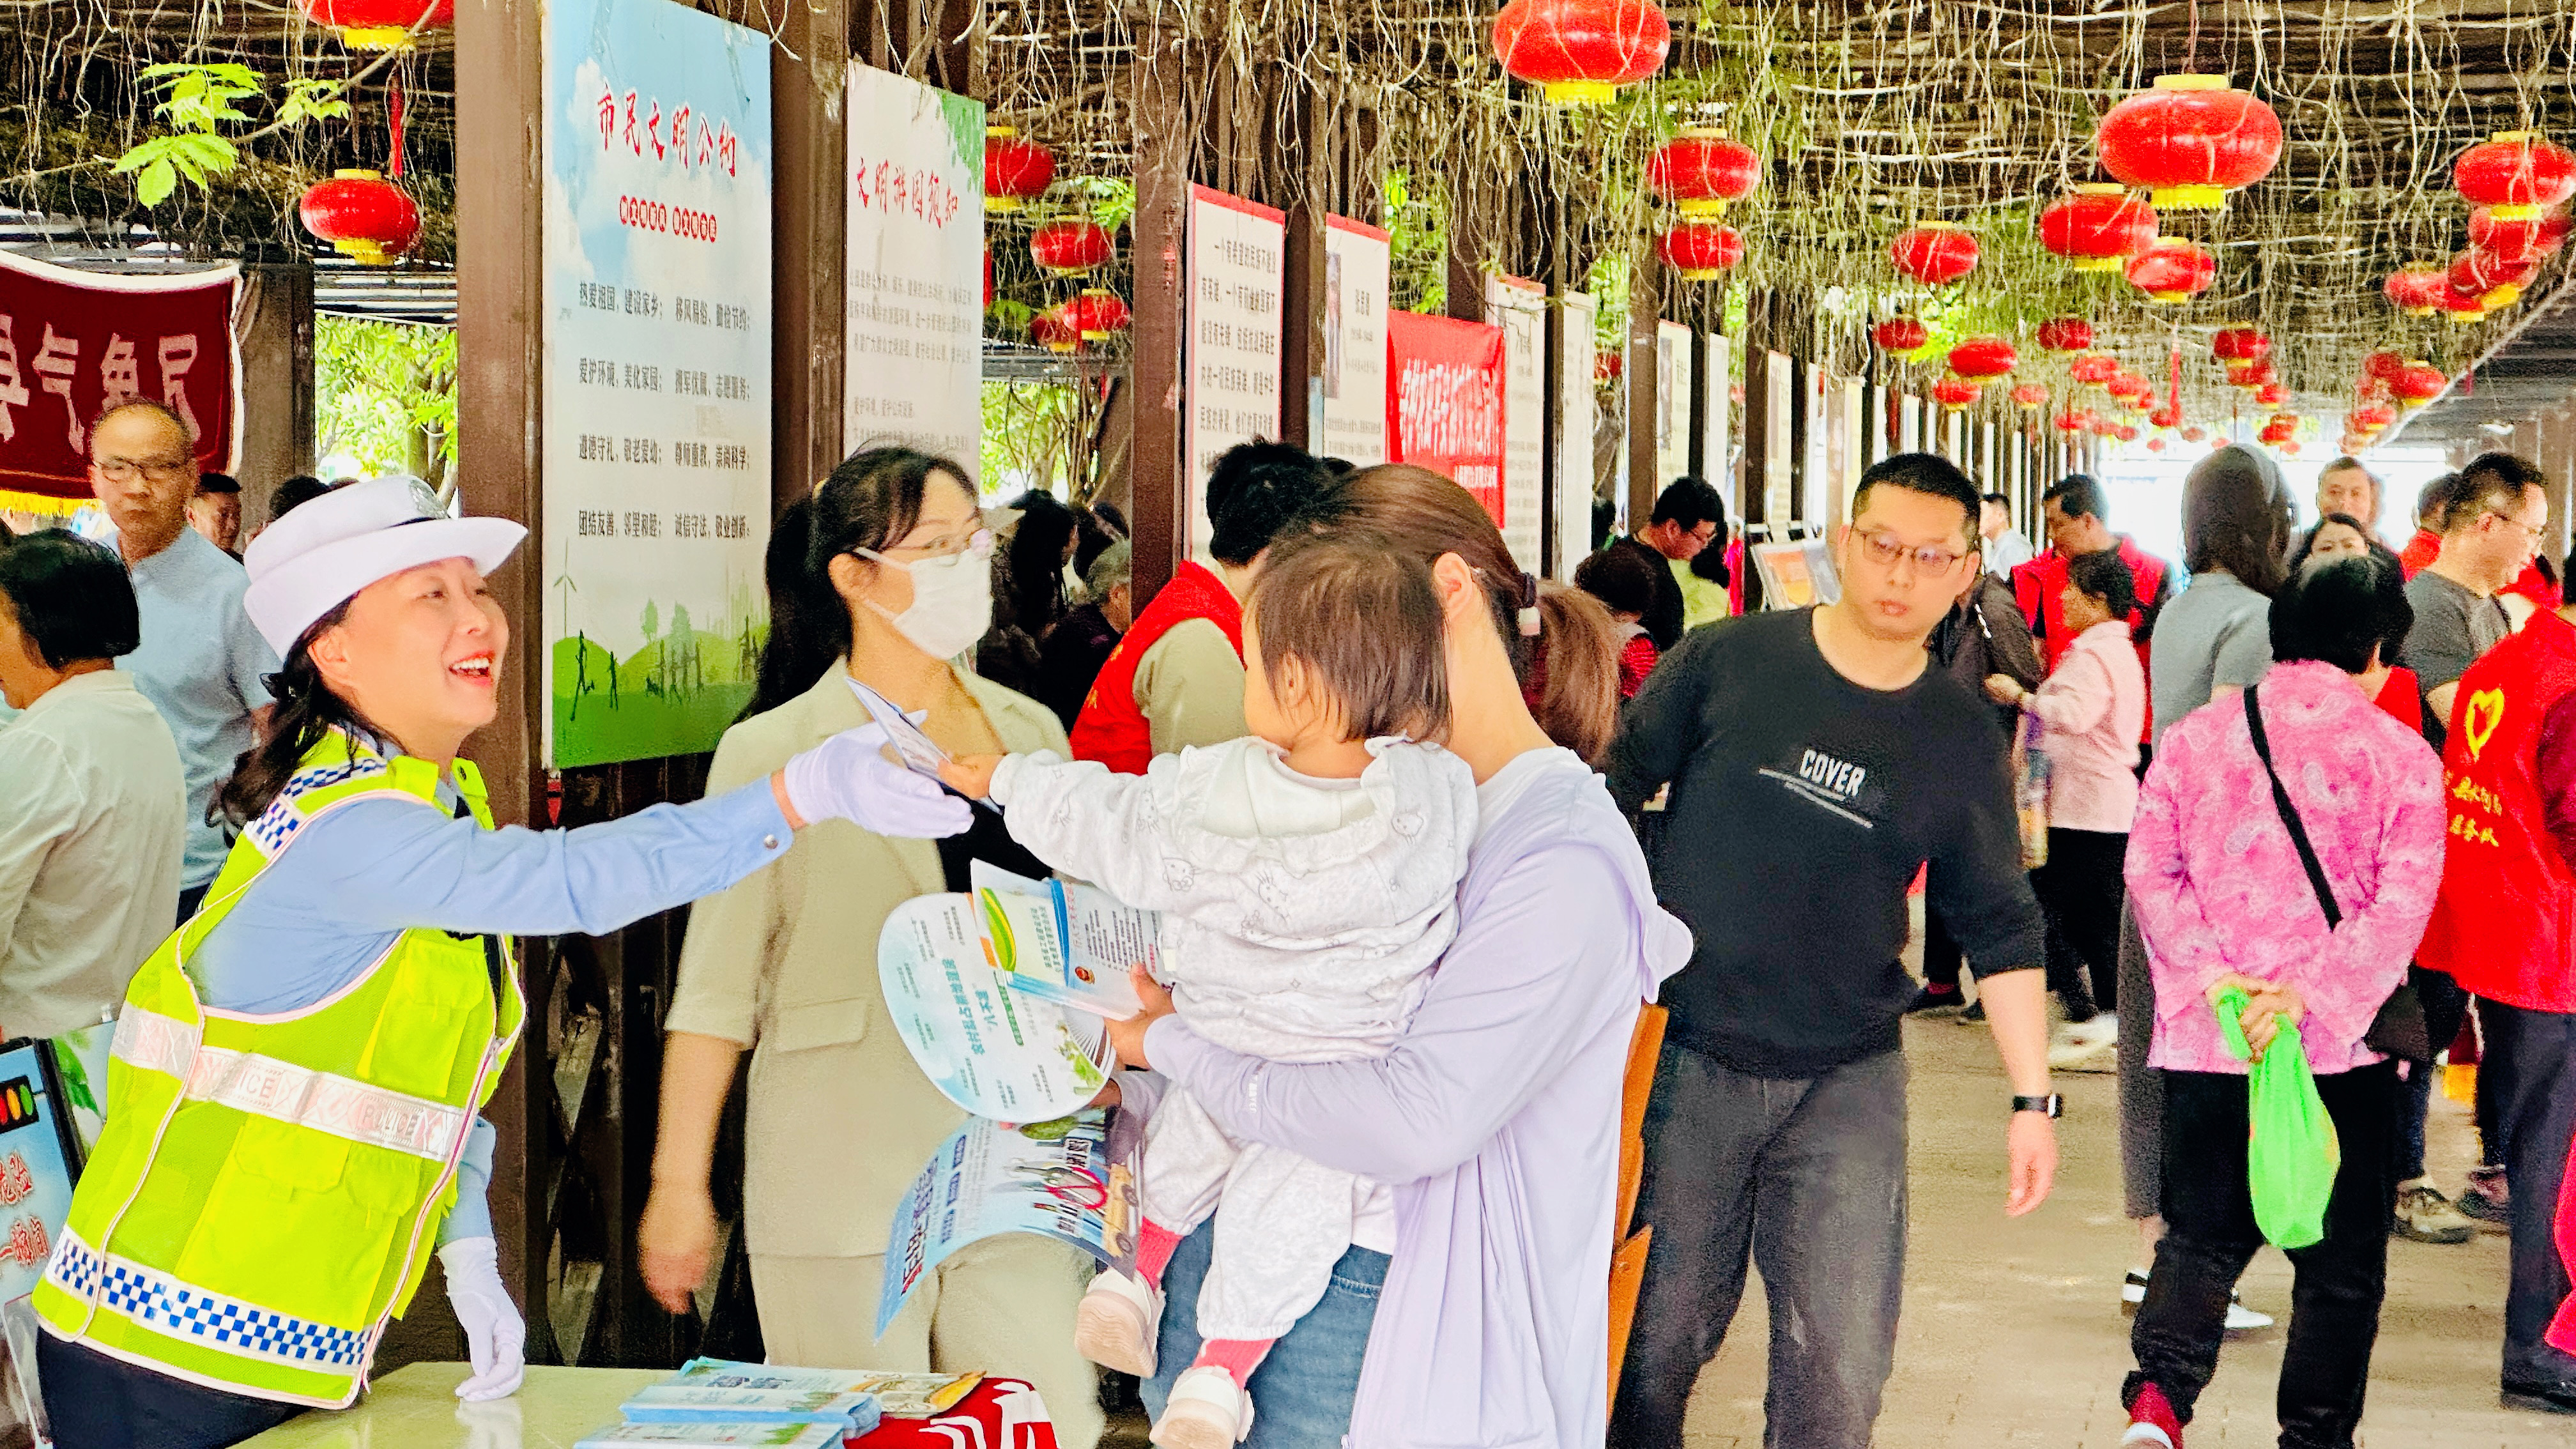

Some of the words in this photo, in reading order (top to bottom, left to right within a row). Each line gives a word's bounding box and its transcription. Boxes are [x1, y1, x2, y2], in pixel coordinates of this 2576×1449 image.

[597, 80, 736, 178] 市民文明公约
[1799, 748, 1866, 797] COVER
[363, 1100, 419, 1140] POLICE
